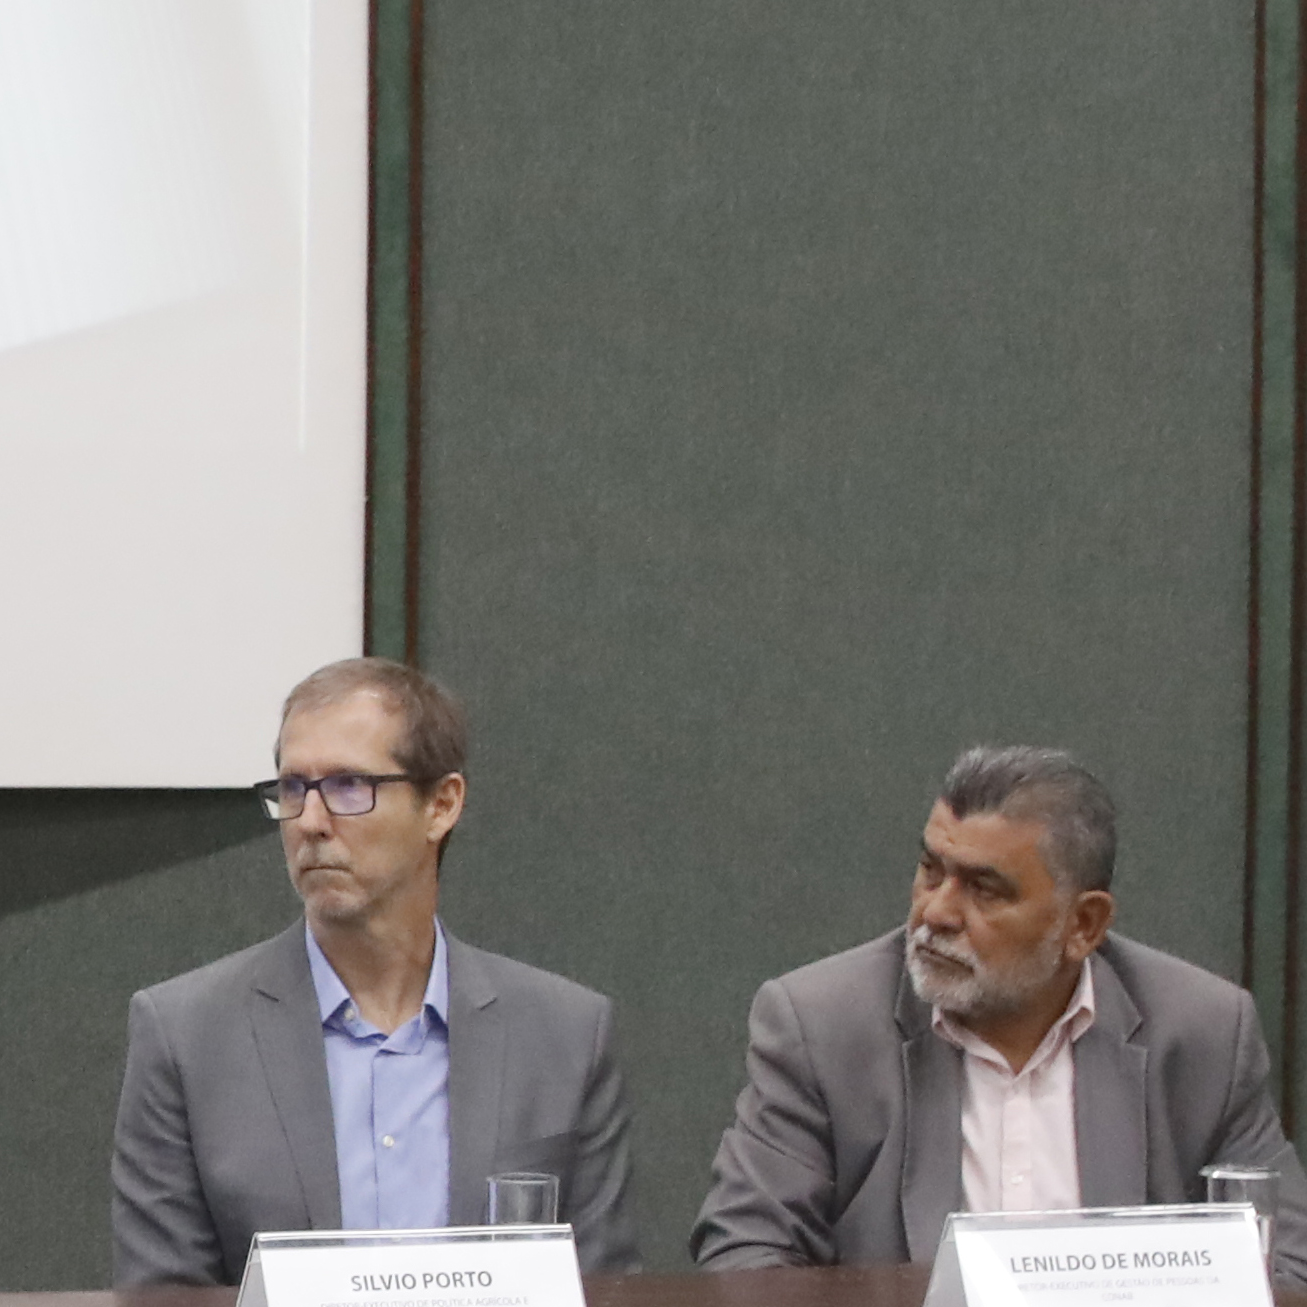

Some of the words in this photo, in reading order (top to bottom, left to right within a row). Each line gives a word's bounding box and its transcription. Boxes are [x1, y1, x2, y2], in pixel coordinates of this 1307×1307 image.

[1009, 1254, 1098, 1274] LENILDO
[1102, 1252, 1129, 1270] DE
[1132, 1249, 1213, 1269] MORAIS
[350, 1273, 417, 1293] SILVIO
[422, 1270, 493, 1290] PORTO
